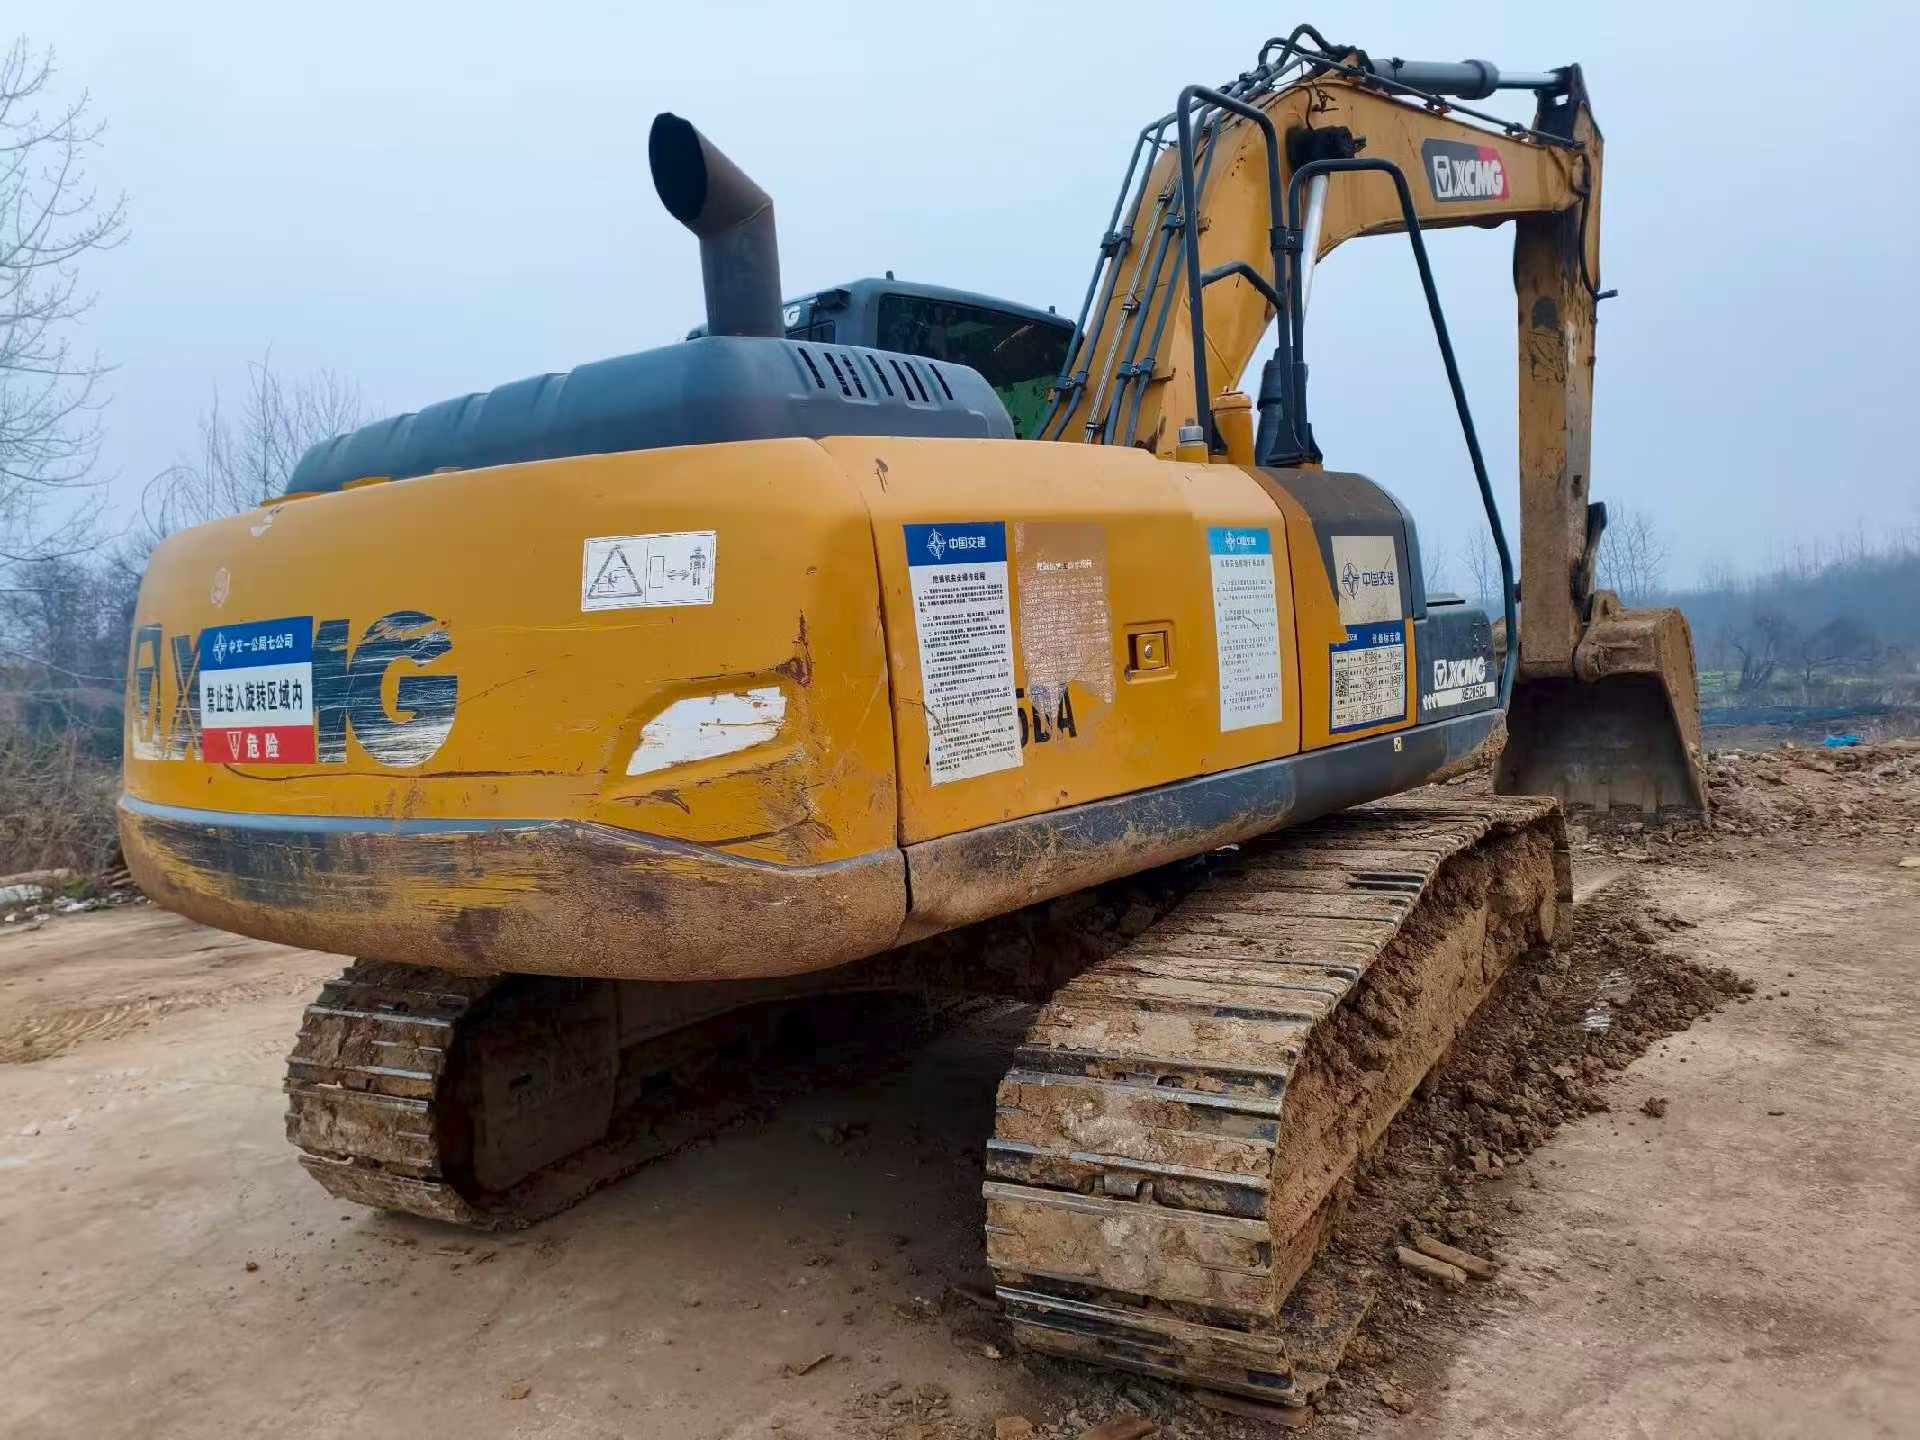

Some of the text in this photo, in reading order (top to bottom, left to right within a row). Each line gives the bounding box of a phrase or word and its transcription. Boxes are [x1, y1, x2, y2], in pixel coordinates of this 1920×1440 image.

[1452, 160, 1504, 196] XCMG
[948, 536, 986, 550] 中国交建
[1362, 570, 1394, 587] 中国交建
[229, 633, 294, 654] 中交一公局七公司
[1447, 656, 1487, 688] XCMG
[207, 678, 303, 714] 禁止进入旋转区域内
[247, 733, 280, 758] 危险
